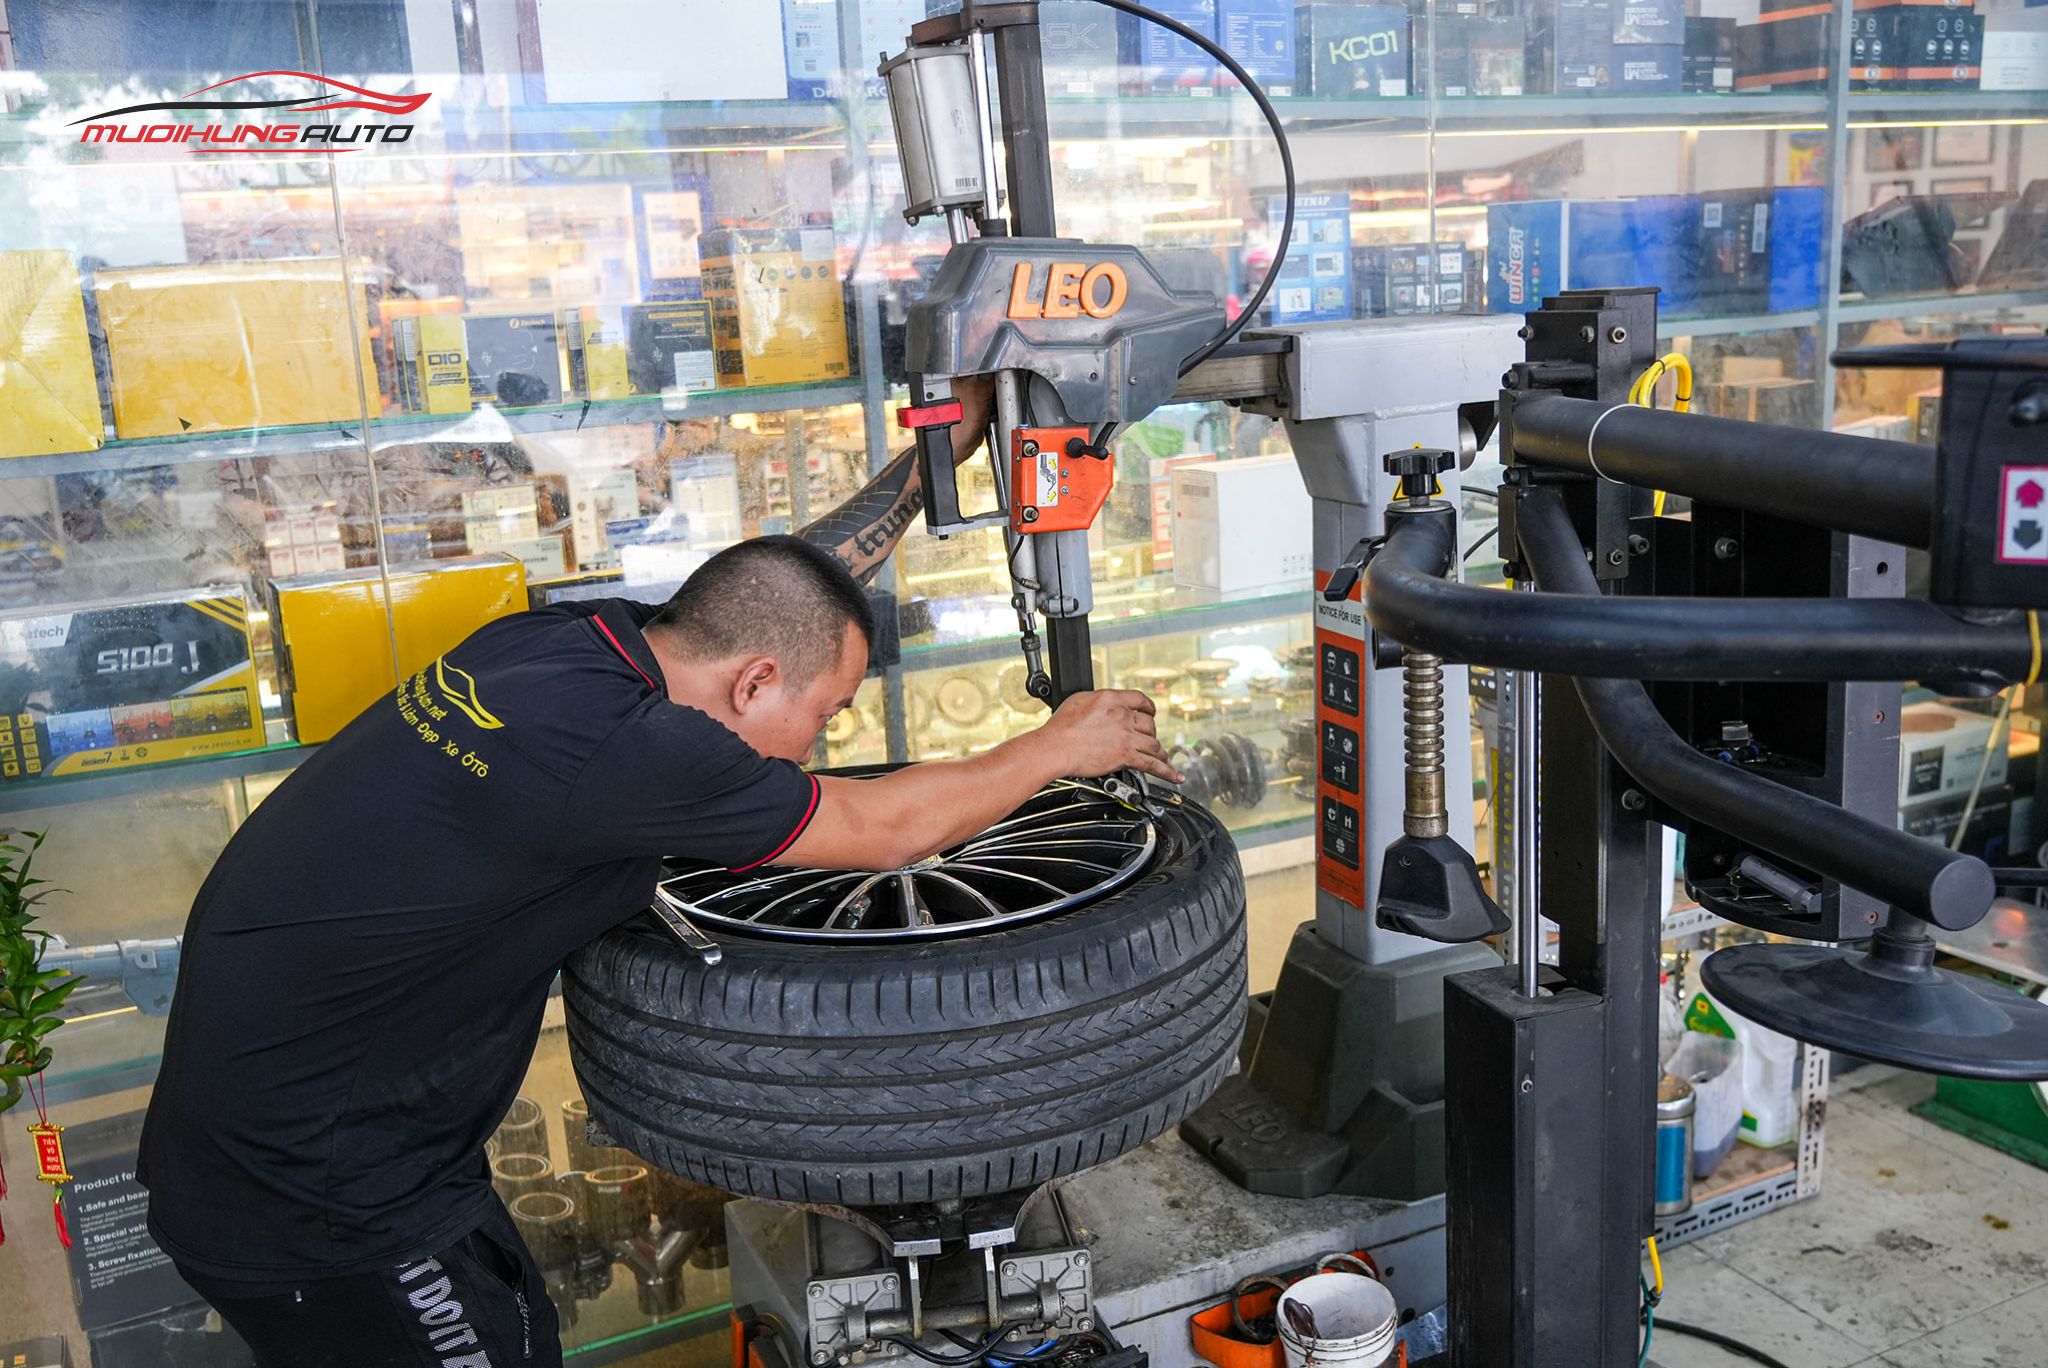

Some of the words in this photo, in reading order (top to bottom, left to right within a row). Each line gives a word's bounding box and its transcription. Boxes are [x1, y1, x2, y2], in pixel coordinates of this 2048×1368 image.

[1007, 262, 1128, 319] LEO
[427, 352, 462, 366] DIO
[1318, 604, 1338, 619] NOTICE
[1338, 609, 1350, 622] FOR
[1350, 613, 1362, 626] USE
[417, 722, 440, 743] Đẹp
[441, 740, 459, 757] Xe
[74, 1174, 120, 1194] Product
[78, 1200, 107, 1214] 1.Safe
[108, 1195, 126, 1207] and
[83, 1237, 93, 1246] 2.
[93, 1227, 127, 1244] Special
[98, 1255, 127, 1269] Screw
[127, 1246, 161, 1262] fixation
